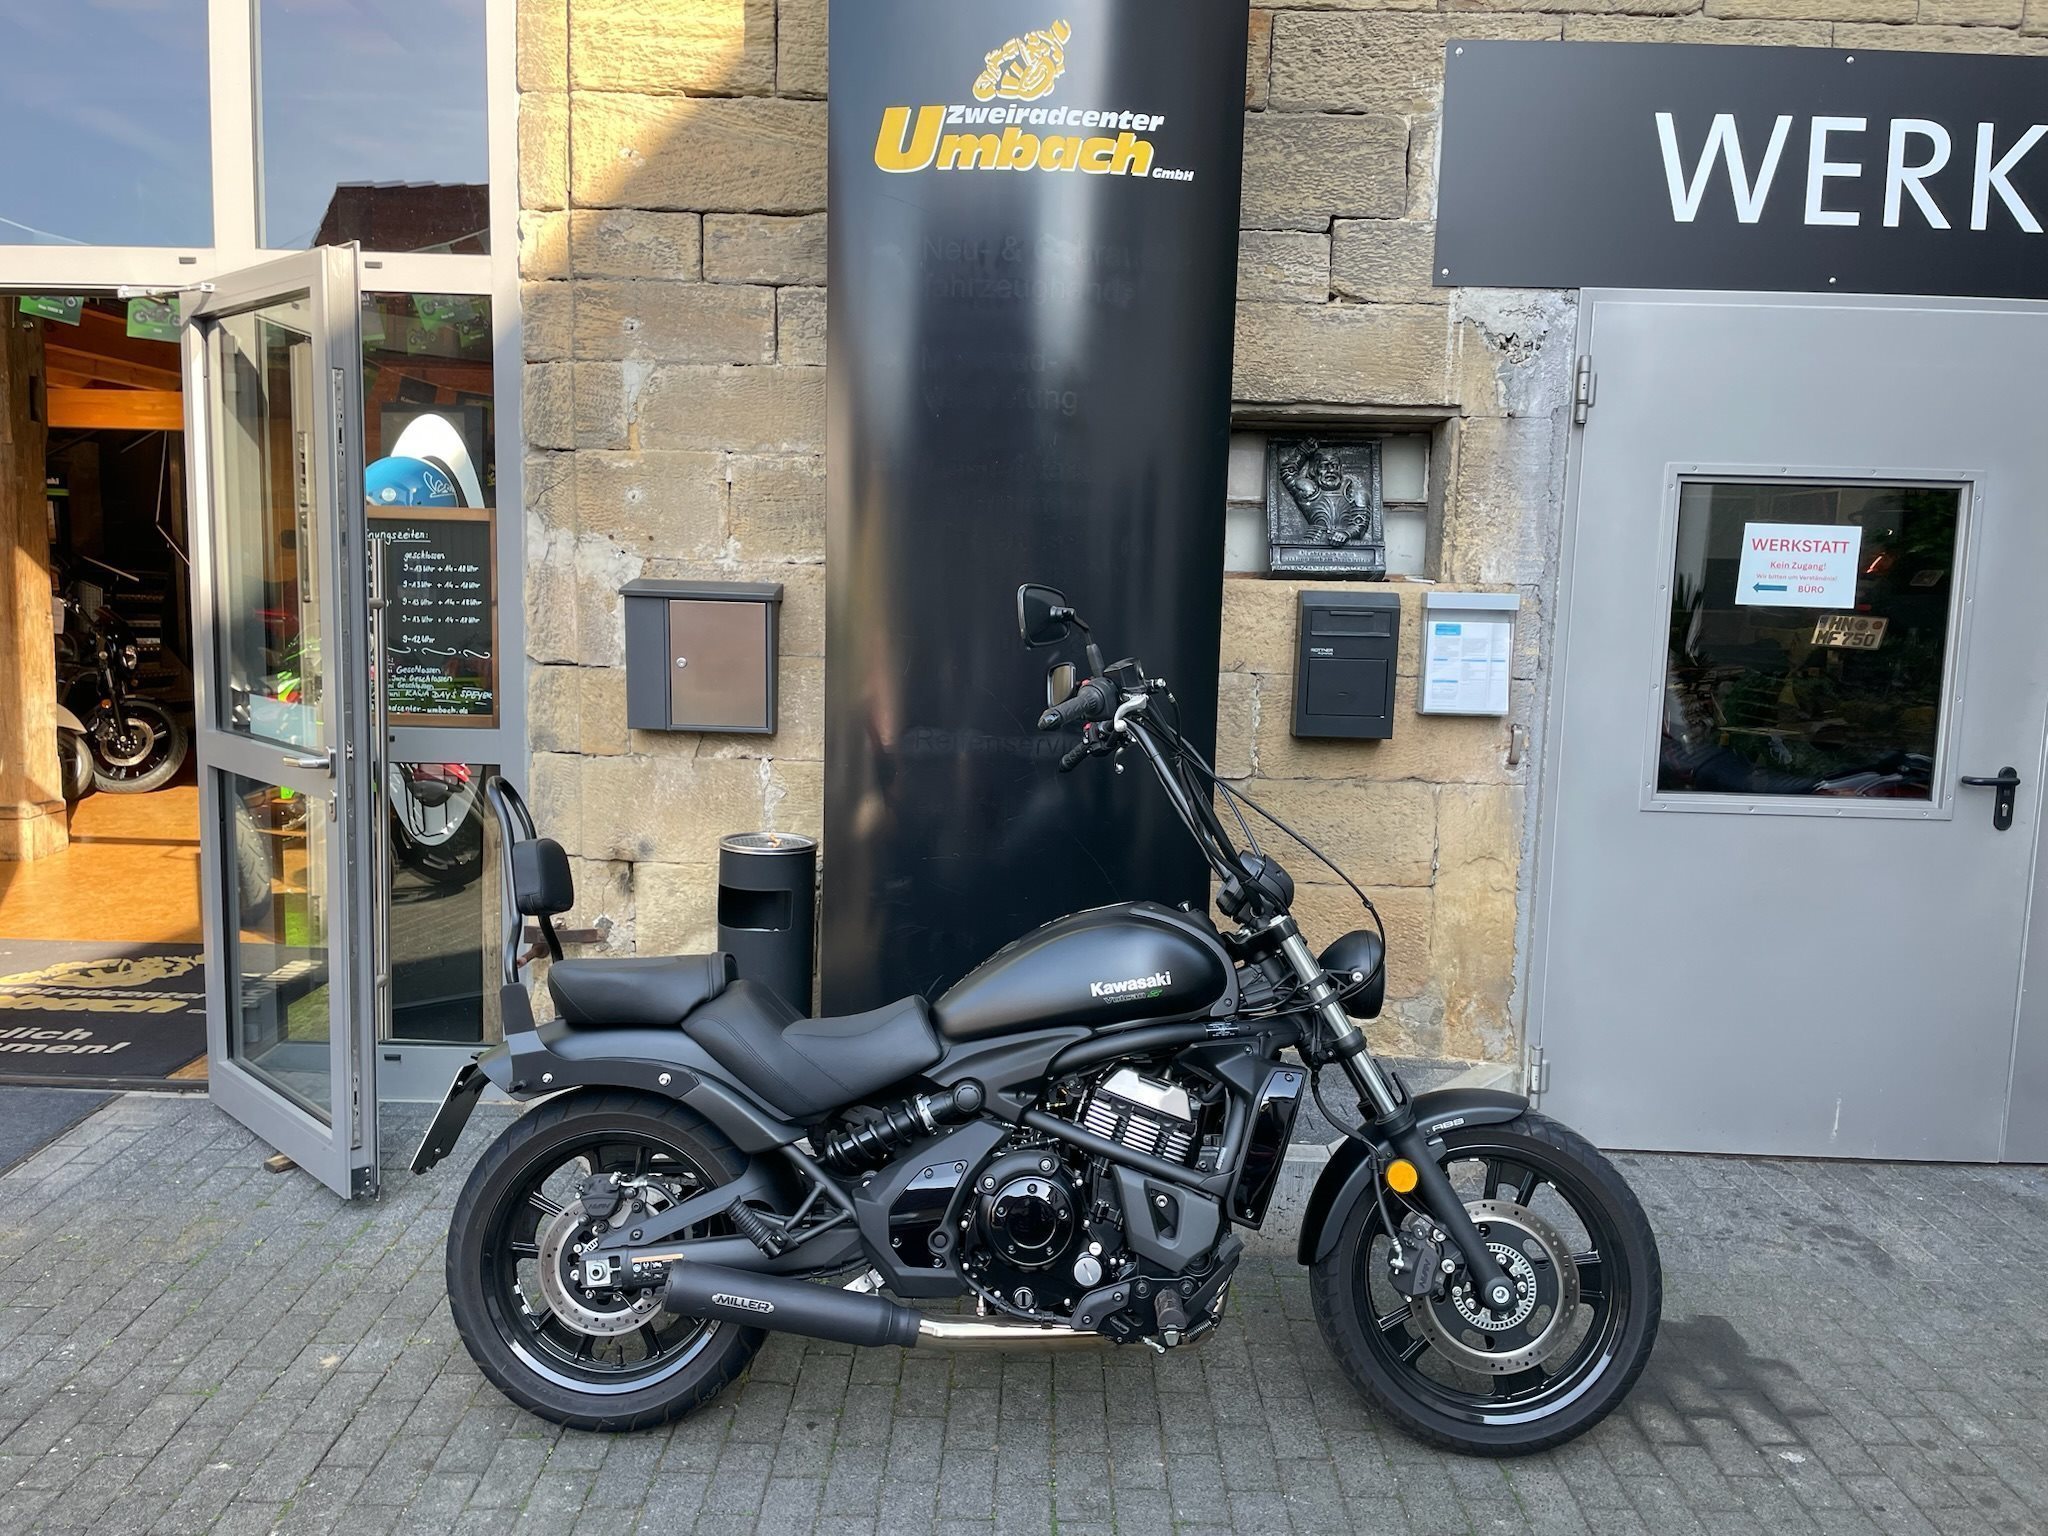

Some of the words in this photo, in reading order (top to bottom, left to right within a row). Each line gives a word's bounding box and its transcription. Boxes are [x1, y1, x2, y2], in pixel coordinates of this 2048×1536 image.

[946, 104, 1165, 131] Zweiradcenter
[874, 104, 1155, 177] Umbach
[1152, 167, 1195, 182] GmbH
[1655, 112, 2048, 233] WERK
[1752, 538, 1850, 554] WERKSTATT
[1770, 561, 1790, 569] Kein
[1791, 562, 1827, 571] Zugang!
[1797, 584, 1825, 593] BÜRO
[1828, 617, 1855, 631] HN
[1841, 632, 1876, 646] 750
[1090, 971, 1172, 997] Kawasaki
[716, 1295, 770, 1312] MILLER
